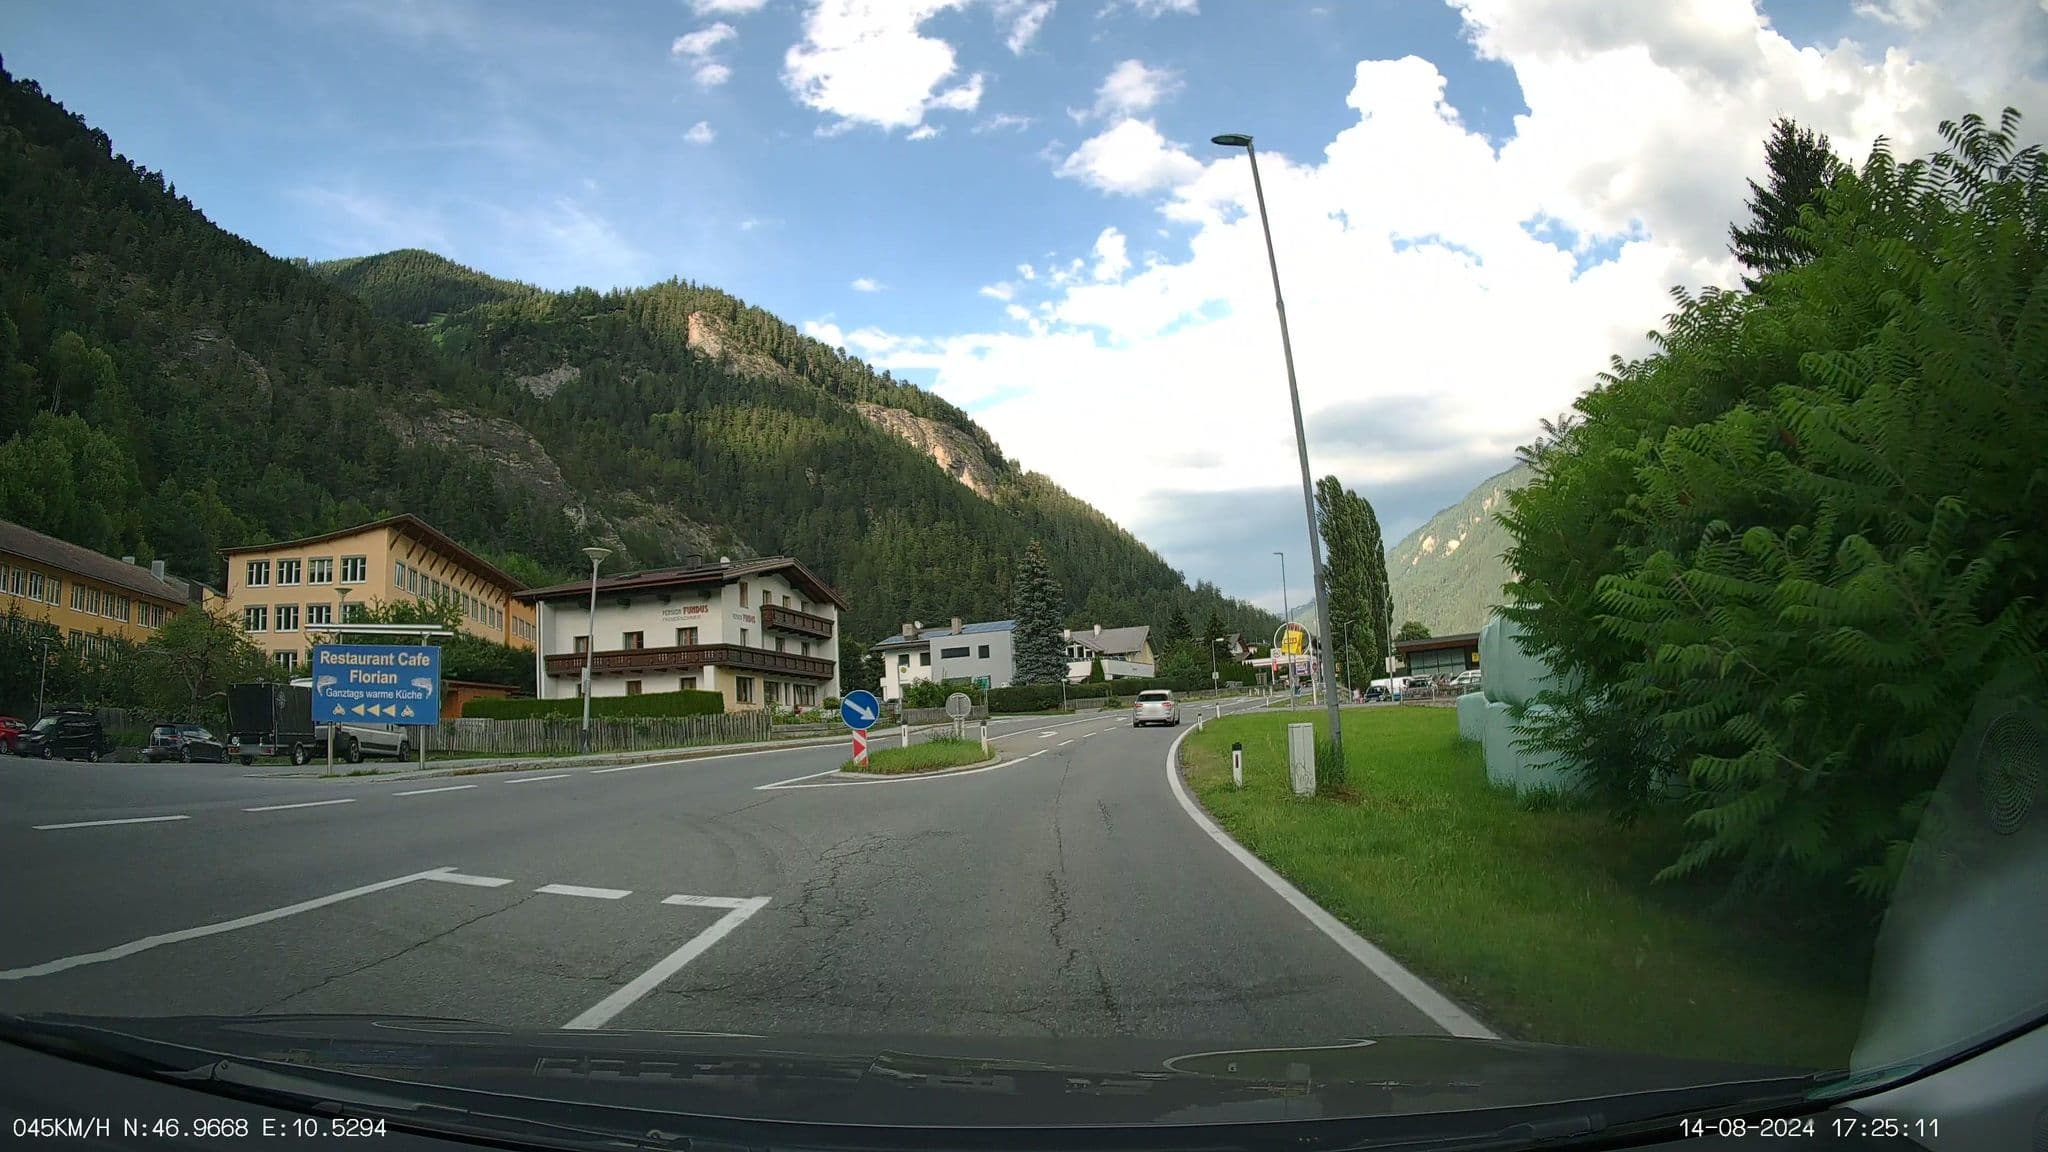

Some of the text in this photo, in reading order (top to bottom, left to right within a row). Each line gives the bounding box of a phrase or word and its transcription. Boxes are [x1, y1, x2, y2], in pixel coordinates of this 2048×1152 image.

[682, 604, 709, 615] FUNDUS
[320, 651, 430, 667] Restaurant Cafe
[349, 669, 398, 684] Florian
[325, 688, 423, 700] Ganztags warme Küche
